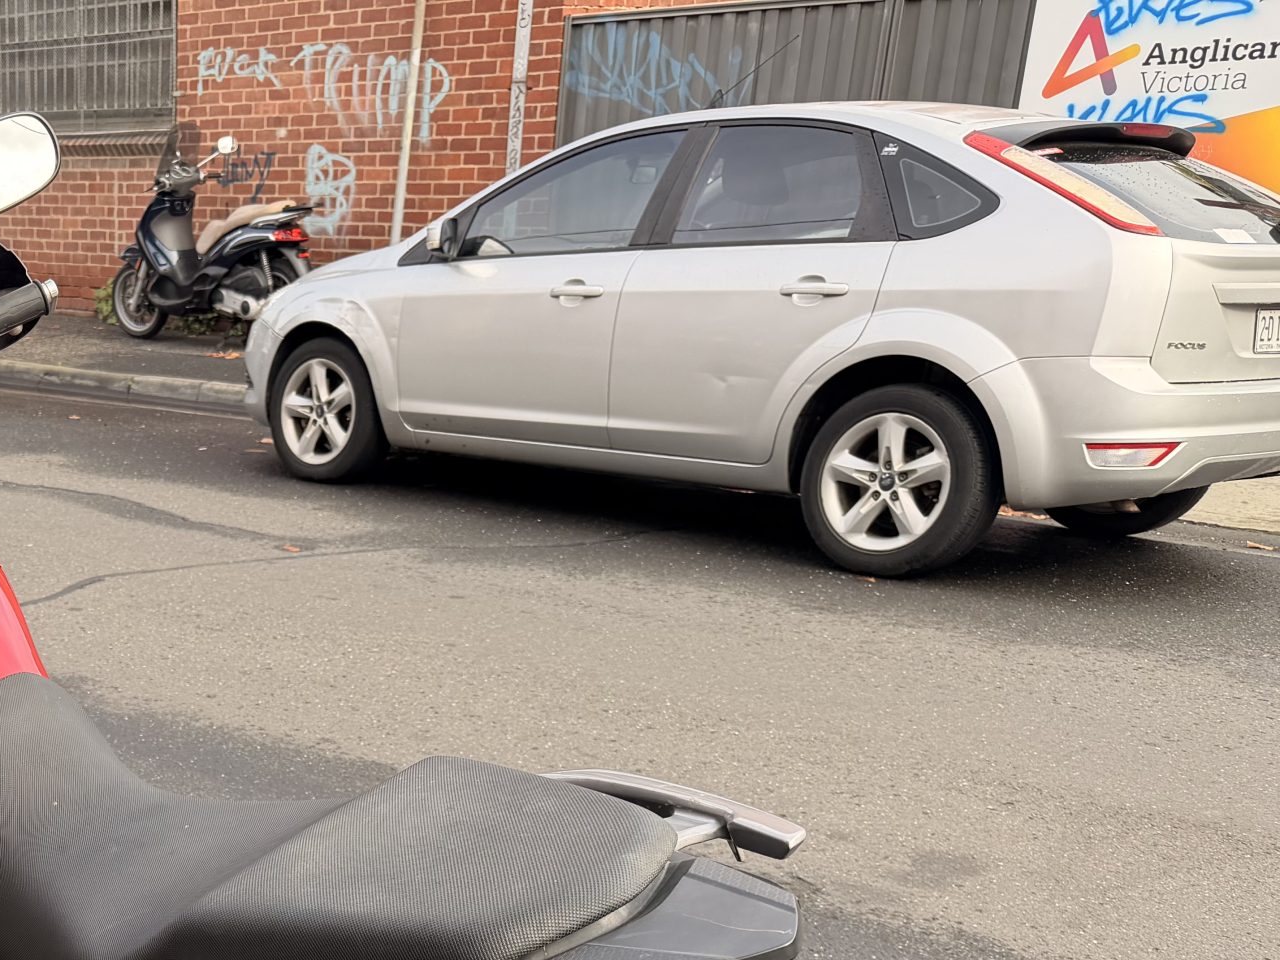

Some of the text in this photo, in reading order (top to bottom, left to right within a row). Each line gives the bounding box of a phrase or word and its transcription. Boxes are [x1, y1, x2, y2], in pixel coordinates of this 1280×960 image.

[1141, 68, 1247, 94] Victoria
[290, 43, 450, 146] TRUMP
[1167, 342, 1207, 350] FOCUS
